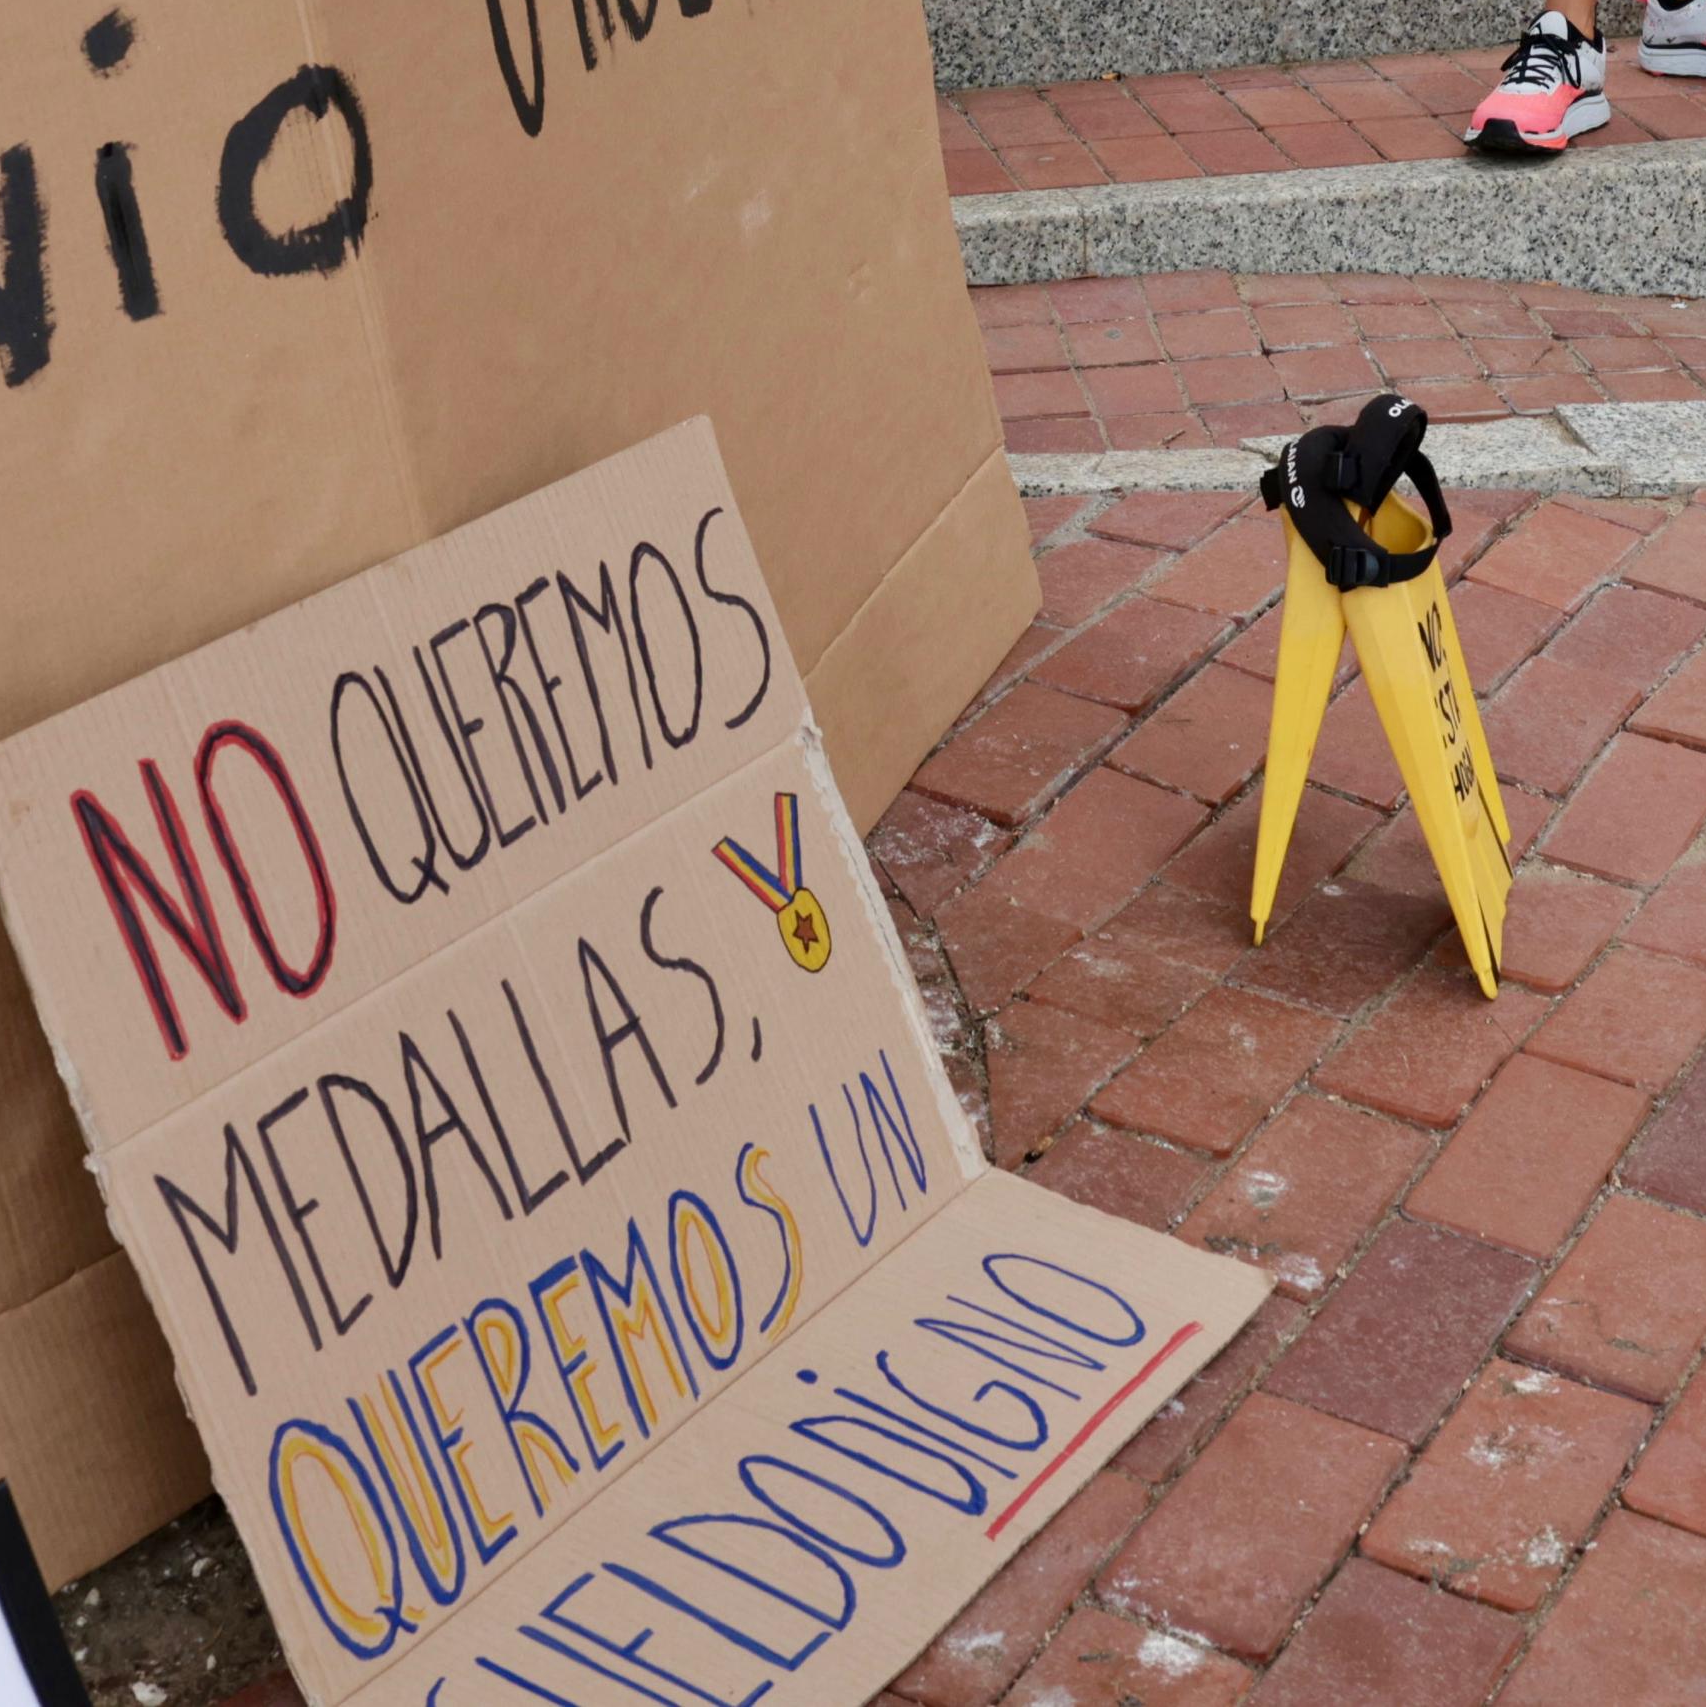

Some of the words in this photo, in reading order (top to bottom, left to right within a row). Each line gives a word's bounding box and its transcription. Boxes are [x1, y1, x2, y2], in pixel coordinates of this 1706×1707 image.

[69, 718, 336, 1062] NO
[329, 506, 771, 905] QUEREMOS
[154, 886, 762, 1396] MEDALLAS,
[267, 1141, 804, 1660] QUEREMOS
[809, 1048, 928, 1247] UN
